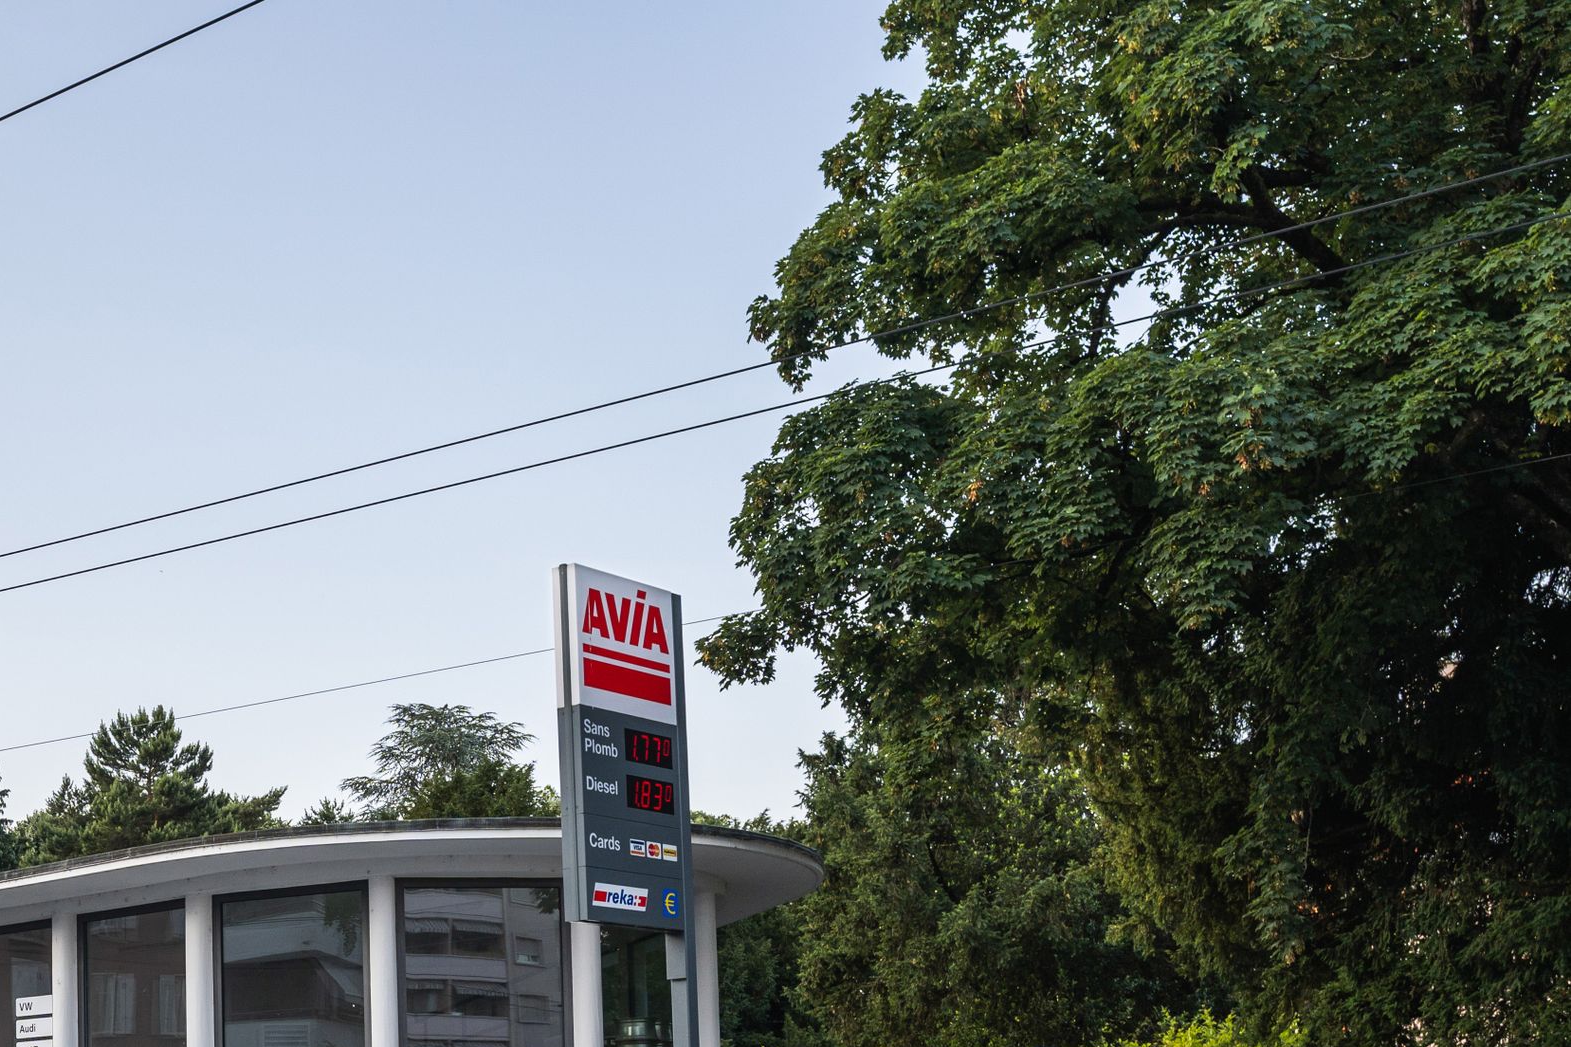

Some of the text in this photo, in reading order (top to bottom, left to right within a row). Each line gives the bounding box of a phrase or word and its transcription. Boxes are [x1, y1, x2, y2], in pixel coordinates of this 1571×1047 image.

[583, 718, 610, 738] Sans
[584, 738, 618, 758] Plomb
[586, 775, 618, 796] Diesel
[589, 832, 621, 851] Cards
[19, 1002, 33, 1012] VW
[19, 1024, 36, 1034] Audi
